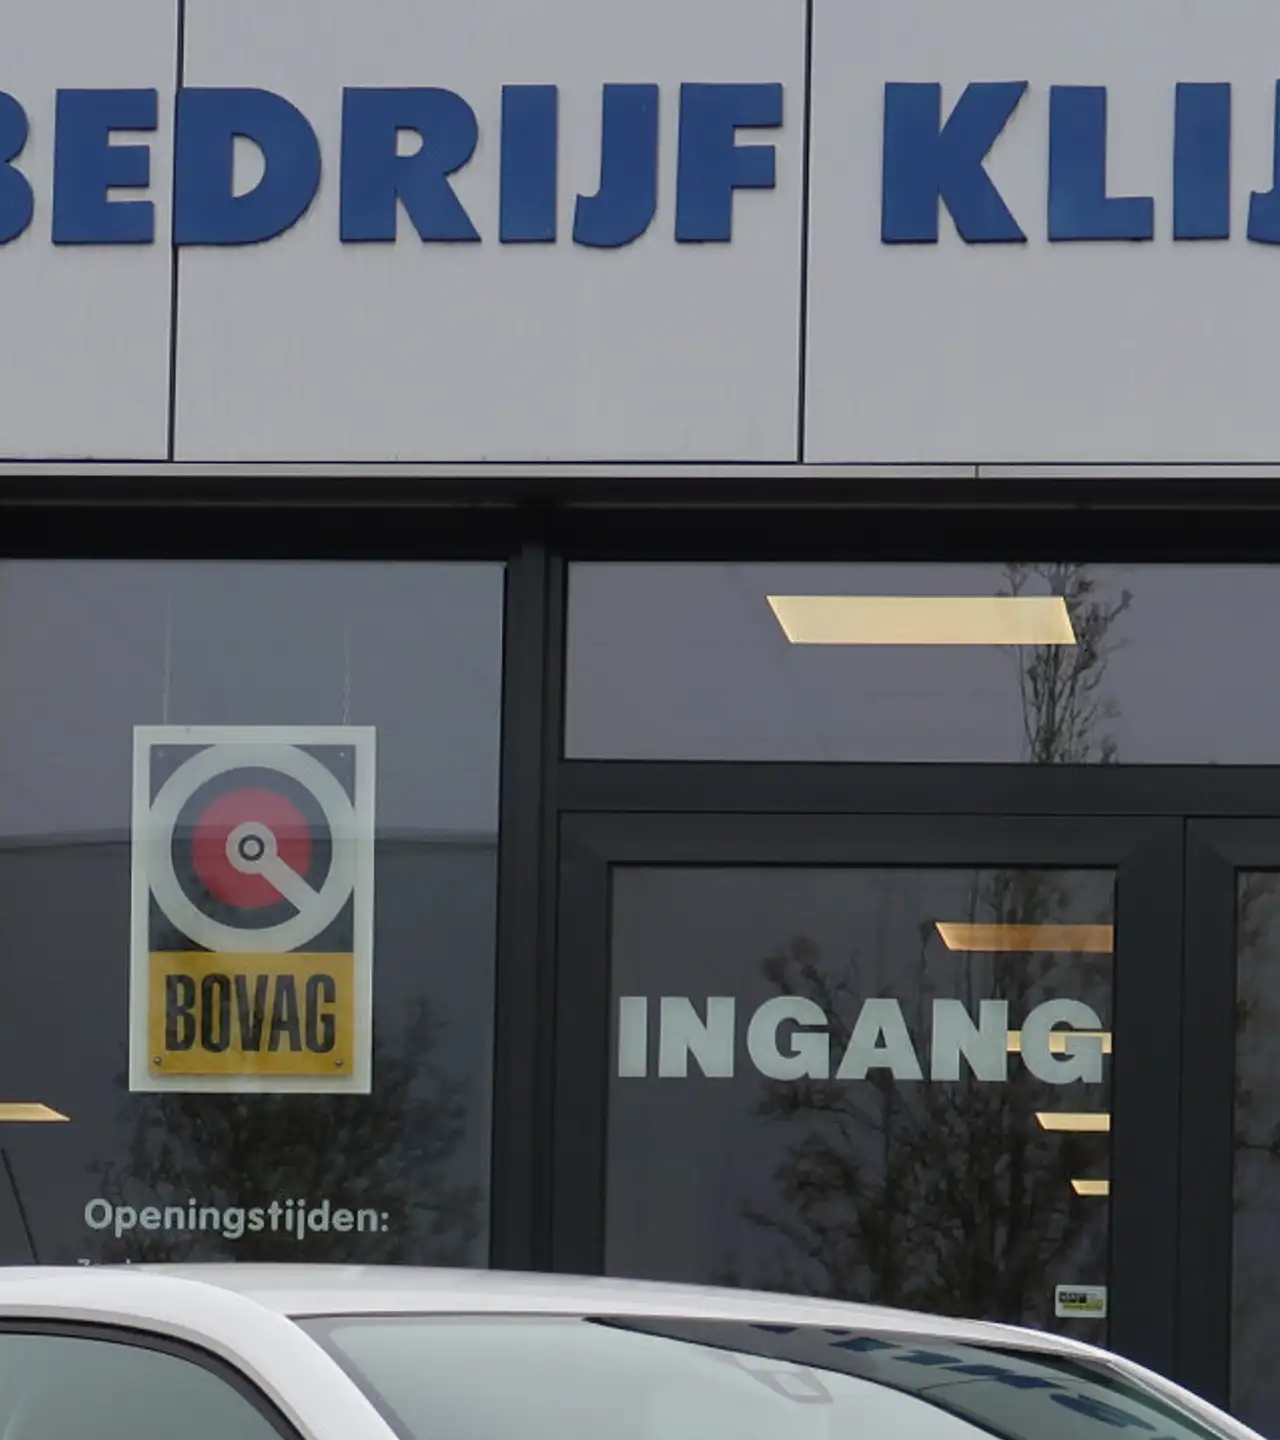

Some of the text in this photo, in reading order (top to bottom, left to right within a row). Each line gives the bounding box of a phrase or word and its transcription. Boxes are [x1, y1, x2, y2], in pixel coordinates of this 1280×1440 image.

[164, 973, 337, 1055] BOVAG
[618, 996, 1104, 1084] INGANG
[84, 1198, 391, 1240] Openingstijden:
